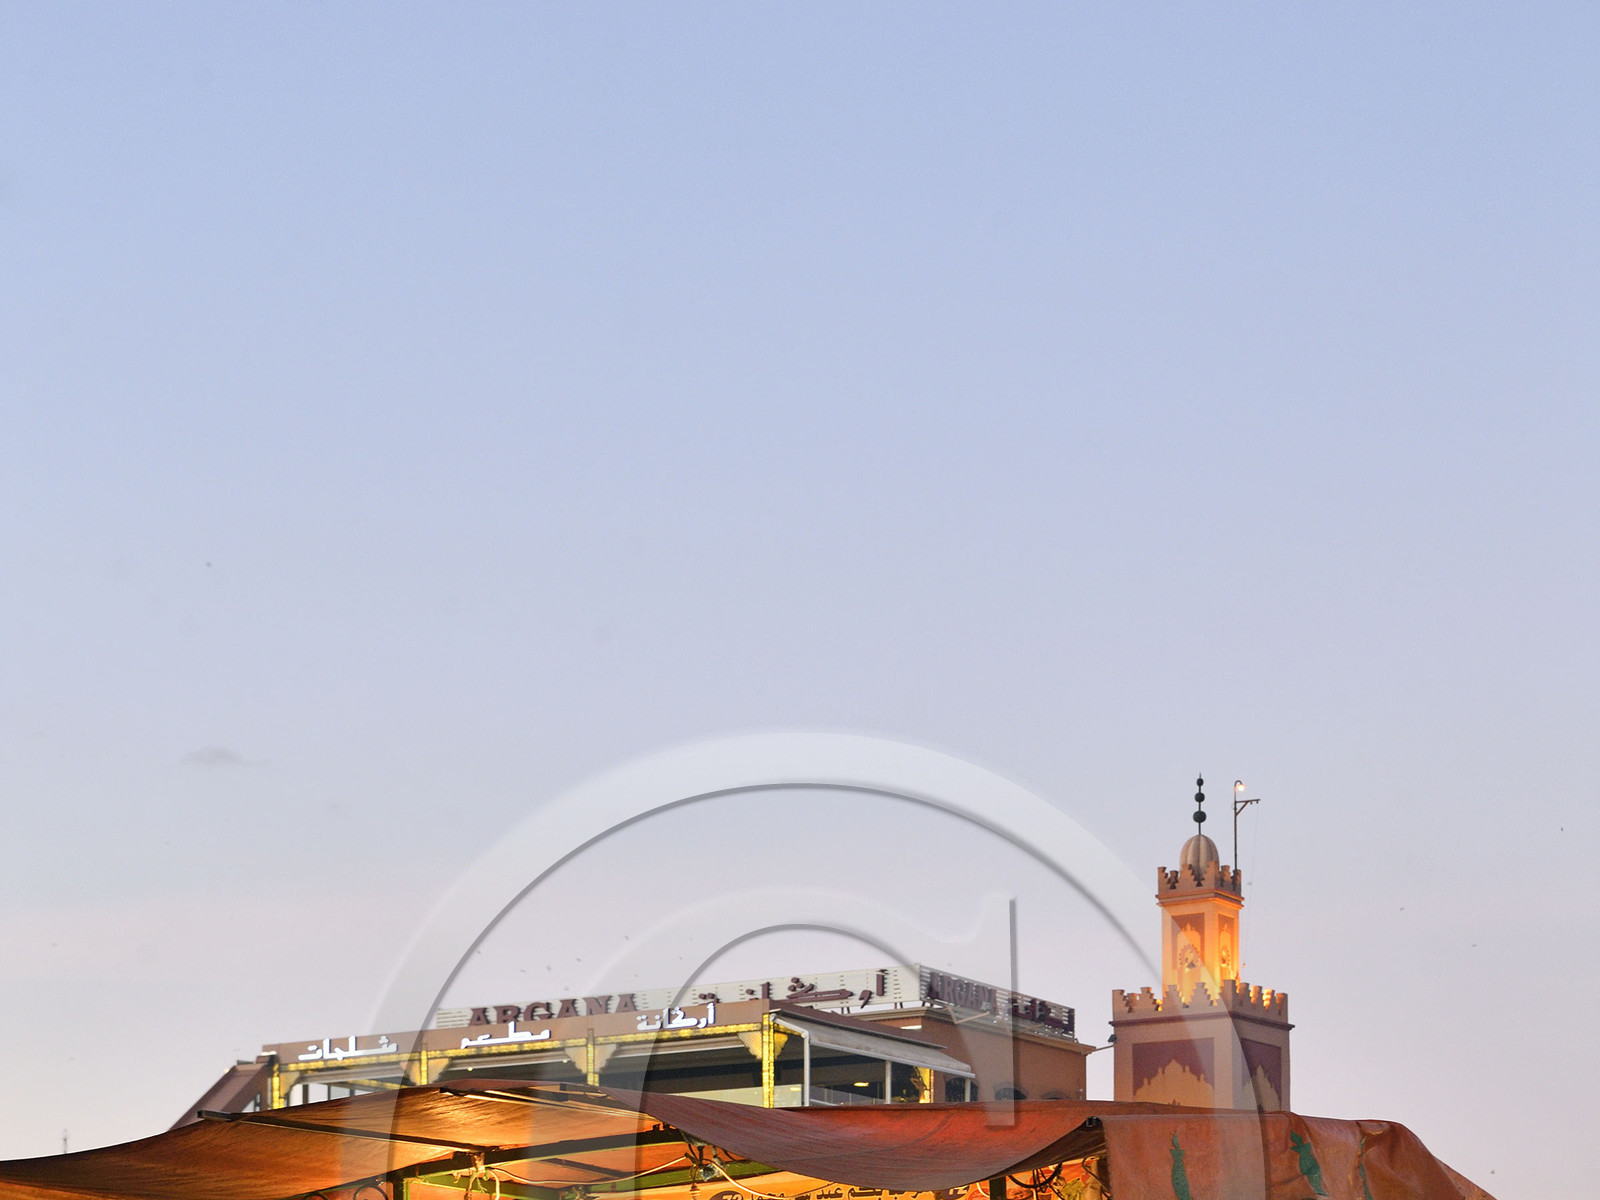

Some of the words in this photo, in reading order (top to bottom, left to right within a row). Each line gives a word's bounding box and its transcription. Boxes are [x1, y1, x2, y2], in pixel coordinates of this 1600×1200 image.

[468, 993, 638, 1027] ARGANA
[298, 1035, 398, 1061] مثلجات
[461, 1021, 551, 1049] مطعم
